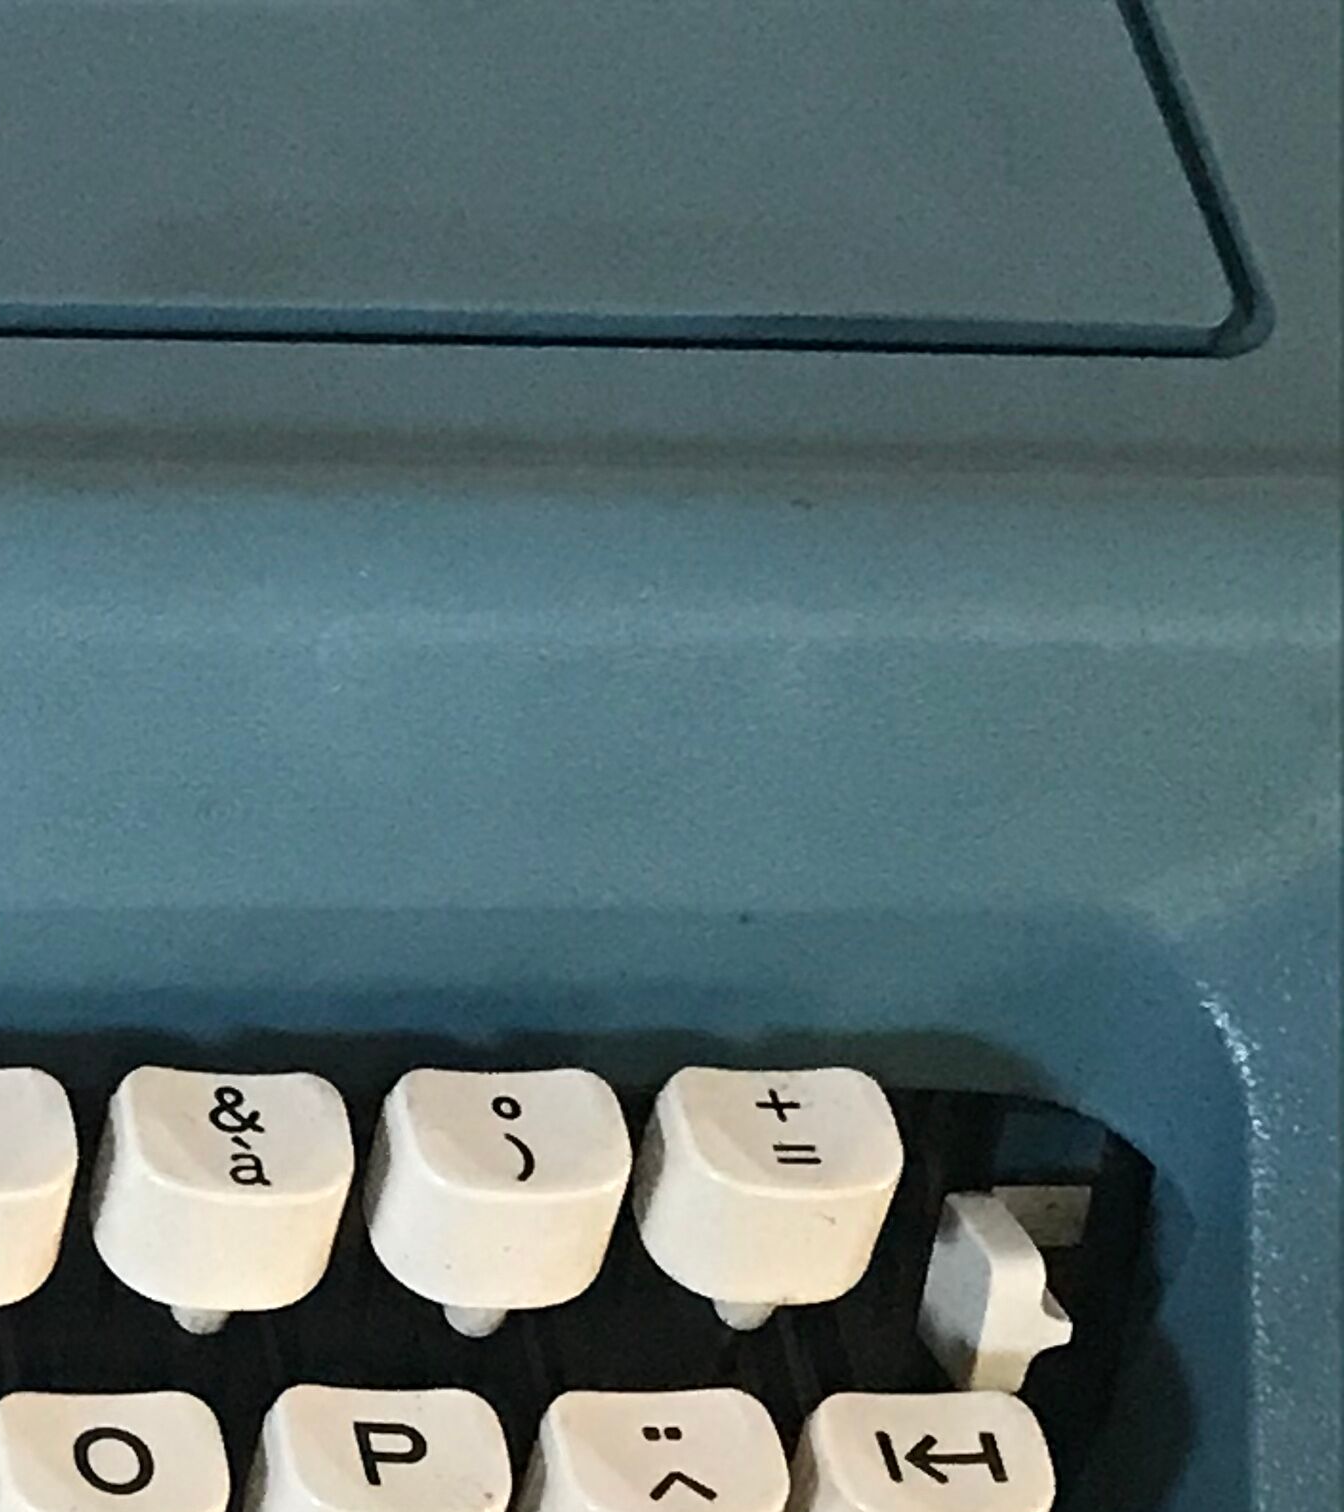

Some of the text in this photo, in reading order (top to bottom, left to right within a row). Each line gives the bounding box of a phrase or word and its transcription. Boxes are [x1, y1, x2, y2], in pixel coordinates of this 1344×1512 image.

[207, 1085, 266, 1135] &
[754, 1087, 802, 1124] +
[228, 1134, 273, 1188] à
[503, 1132, 537, 1183] )
[771, 1142, 823, 1166] =
[71, 1426, 156, 1497] O
[352, 1420, 429, 1487] P
